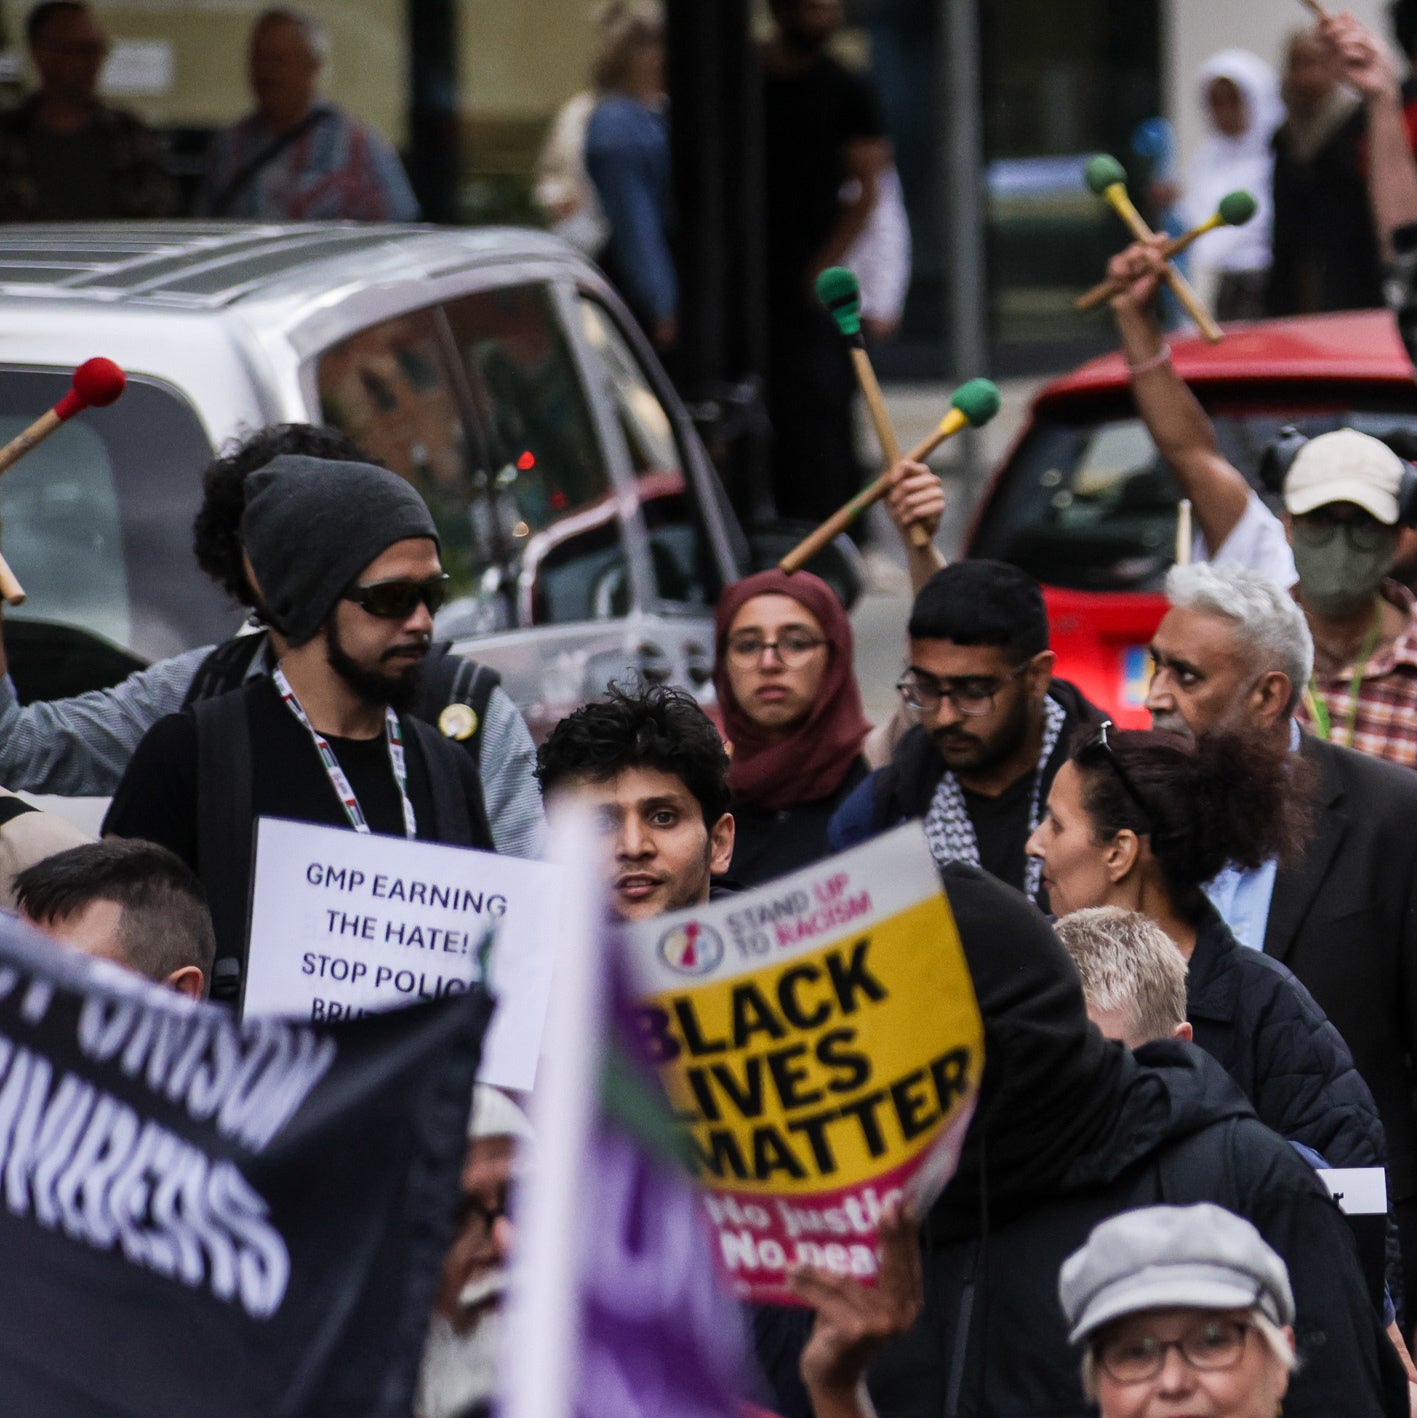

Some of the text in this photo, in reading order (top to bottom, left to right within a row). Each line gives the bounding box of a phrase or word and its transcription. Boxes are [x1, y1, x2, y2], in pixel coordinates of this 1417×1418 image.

[306, 862, 508, 918] GMP EARNING
[725, 872, 850, 936] STAND UP
[327, 909, 469, 954] THE HATE!
[731, 891, 874, 961] TO RACISM
[302, 952, 367, 984] STOP
[634, 937, 889, 1065] BLACK
[686, 1027, 874, 1122] IVES
[690, 1043, 974, 1183] MATTER
[705, 1193, 771, 1230] No
[719, 1230, 786, 1269] No
